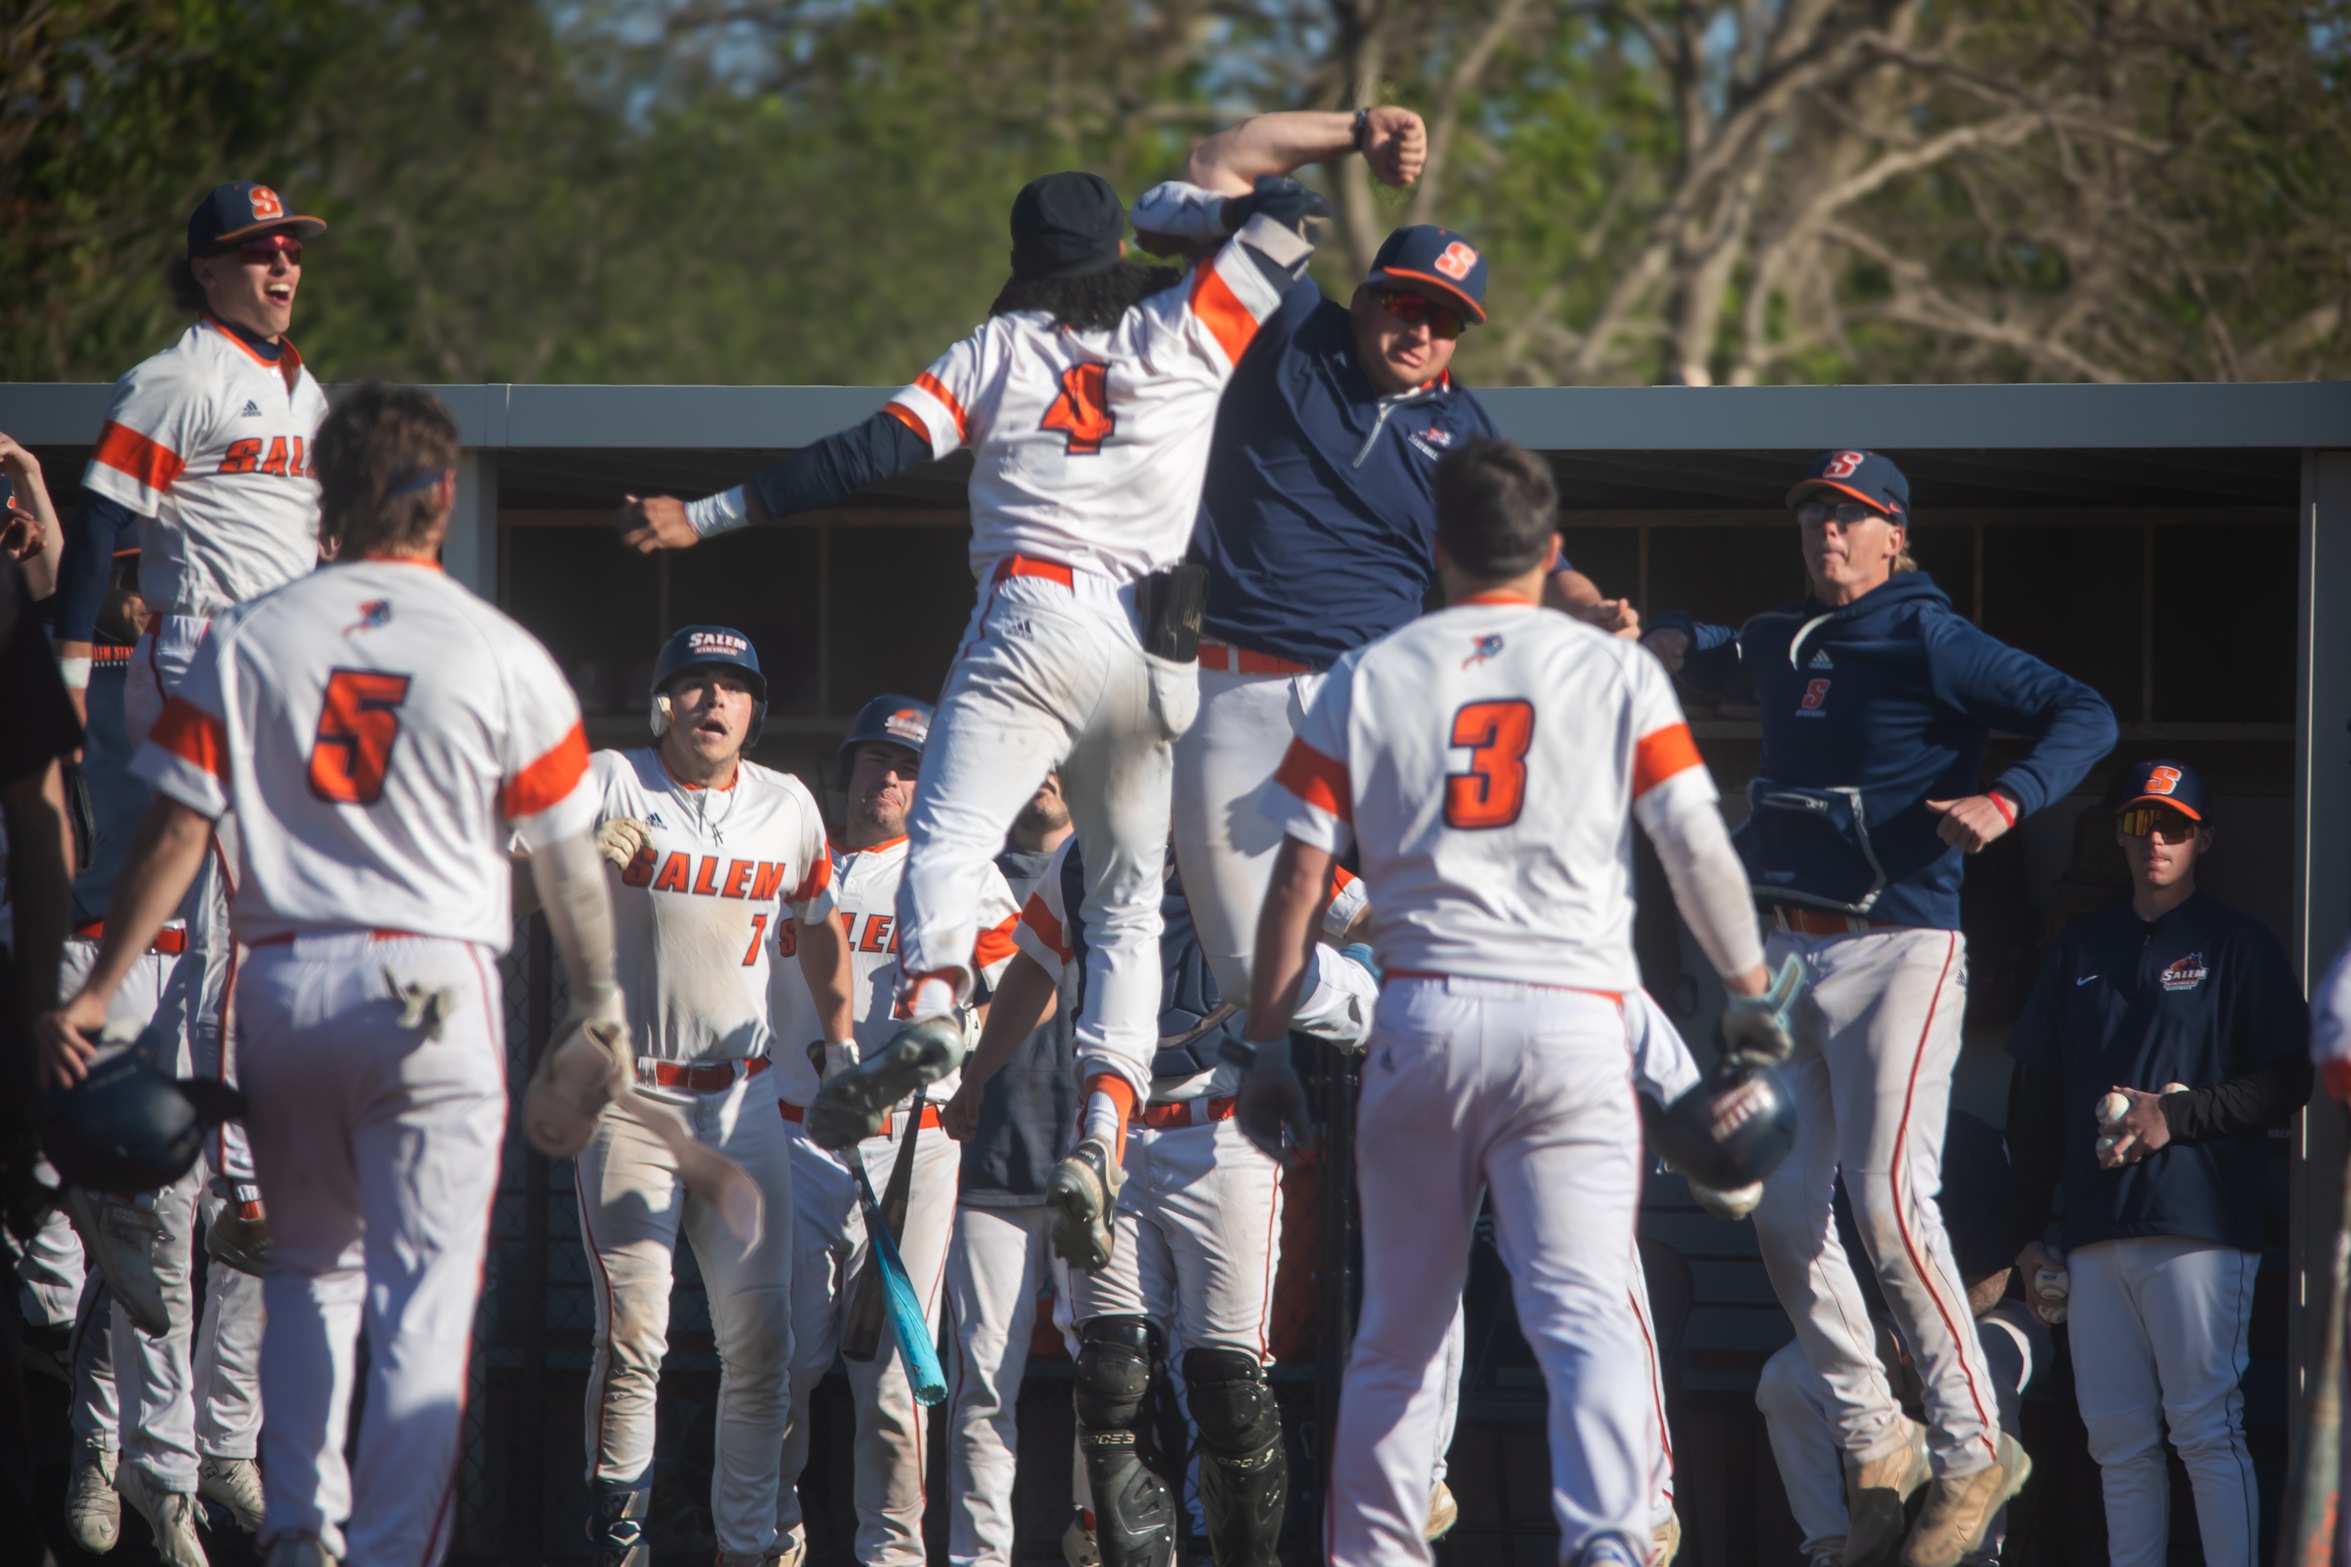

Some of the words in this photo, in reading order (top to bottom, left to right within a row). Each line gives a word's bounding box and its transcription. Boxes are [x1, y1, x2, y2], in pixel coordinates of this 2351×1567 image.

[249, 185, 283, 220] S
[1434, 241, 1476, 281] S
[1037, 362, 1116, 455] 4
[1823, 450, 1864, 478] S
[689, 632, 747, 652] SALEM
[1801, 679, 1830, 709] S
[307, 665, 412, 805] 5
[1441, 698, 1535, 831] 3
[2143, 766, 2182, 795] S
[622, 846, 786, 901] SALEM
[741, 912, 768, 967] 7
[779, 911, 897, 958] SLE
[2161, 969, 2207, 982] SALEM
[1080, 1433, 1136, 1445] ORCE3
